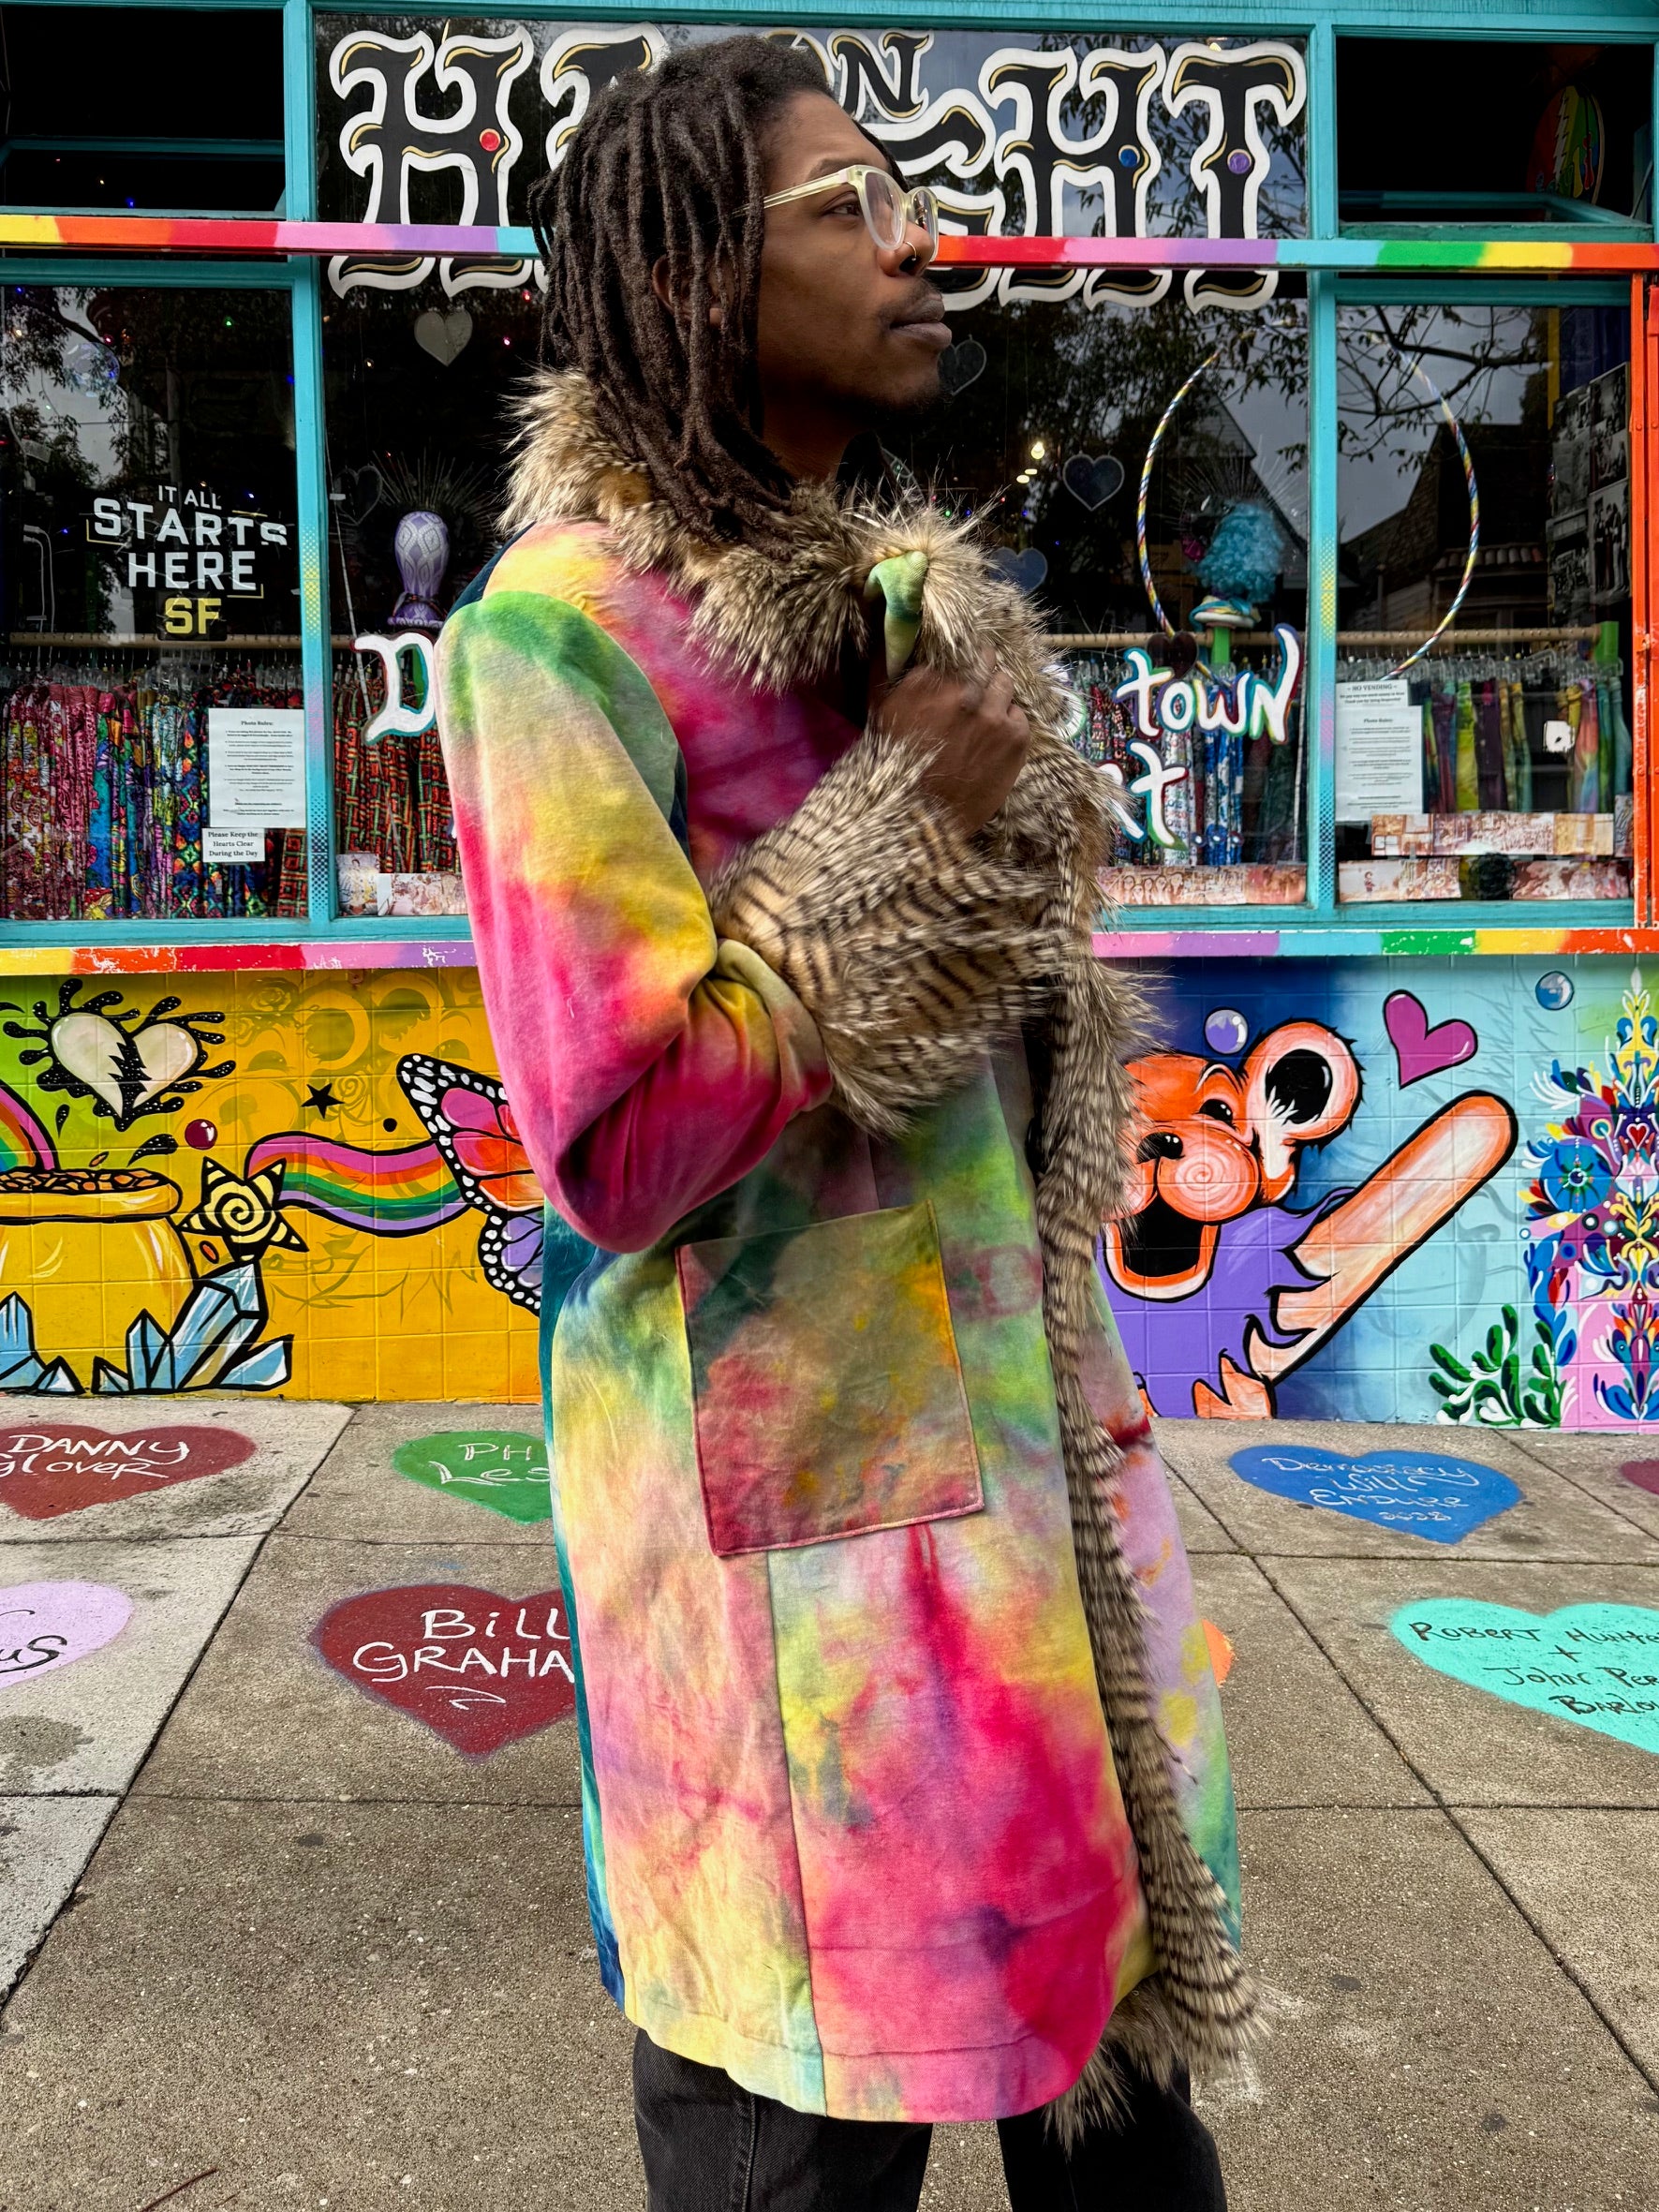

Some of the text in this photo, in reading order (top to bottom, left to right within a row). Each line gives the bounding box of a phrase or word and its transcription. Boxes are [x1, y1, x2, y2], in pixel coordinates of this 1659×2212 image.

[761, 28, 935, 123] N
[330, 27, 1306, 311] HGHT
[158, 484, 222, 511] IT ALL
[94, 497, 288, 546] STARTS
[127, 551, 257, 590] HERE
[164, 597, 222, 635] SF
[230, 831, 245, 839] Keep
[245, 850, 259, 858] Day
[457, 1442, 532, 1462] PH
[428, 1460, 551, 1487] Les
[1563, 1626, 1659, 1646] Hunte
[352, 1641, 575, 1684] GRAHA
